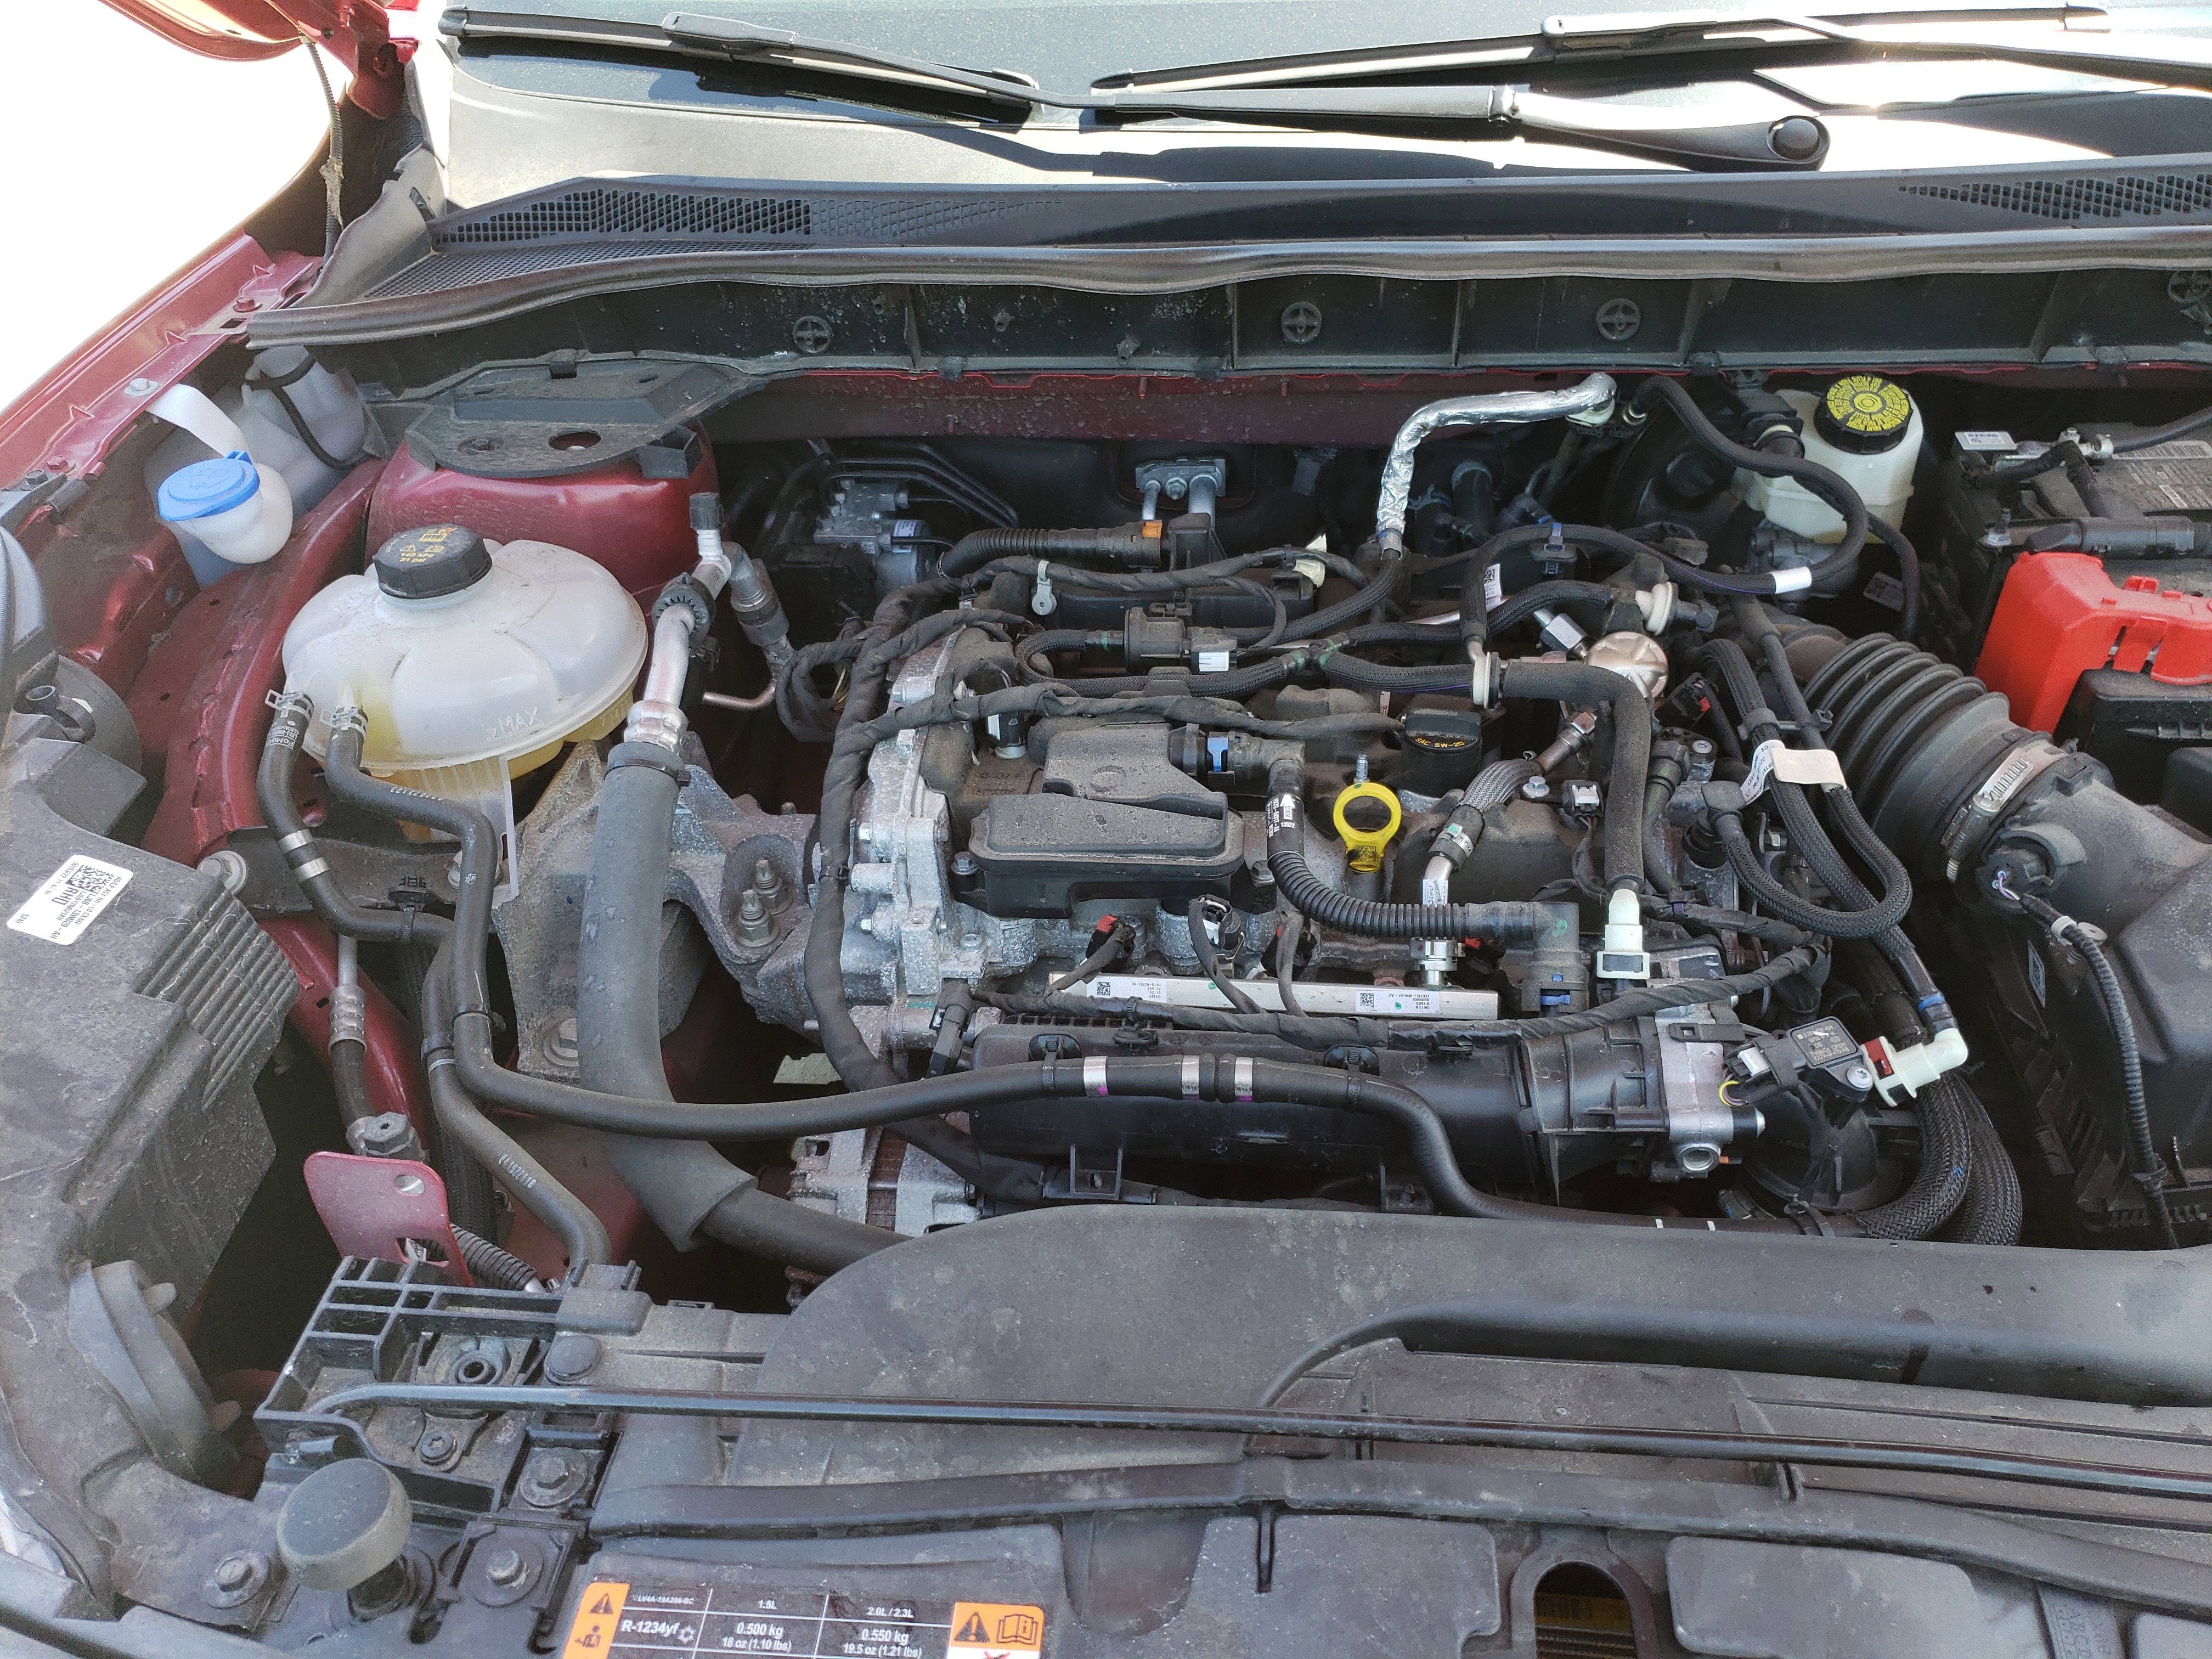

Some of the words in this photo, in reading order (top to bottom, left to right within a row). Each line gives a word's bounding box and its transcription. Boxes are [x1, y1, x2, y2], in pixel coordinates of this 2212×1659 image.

[498, 707, 541, 733] MAX
[757, 1599, 778, 1610] 1.5L
[866, 1606, 888, 1617] 2.0L
[894, 1607, 915, 1618] 2.3L
[622, 1619, 681, 1637] R-1234yf
[736, 1622, 768, 1636] 0.500
[769, 1623, 785, 1640] kg
[861, 1628, 891, 1641] 0.550
[893, 1630, 910, 1645] kg
[722, 1637, 734, 1648] 18
[735, 1640, 748, 1649] oz
[748, 1638, 771, 1651] (1.10
[773, 1639, 792, 1654] lbs)
[843, 1643, 865, 1655] 19.5
[866, 1647, 877, 1656] oz
[878, 1645, 902, 1657] (1.21
[903, 1646, 922, 1659] lbs)
